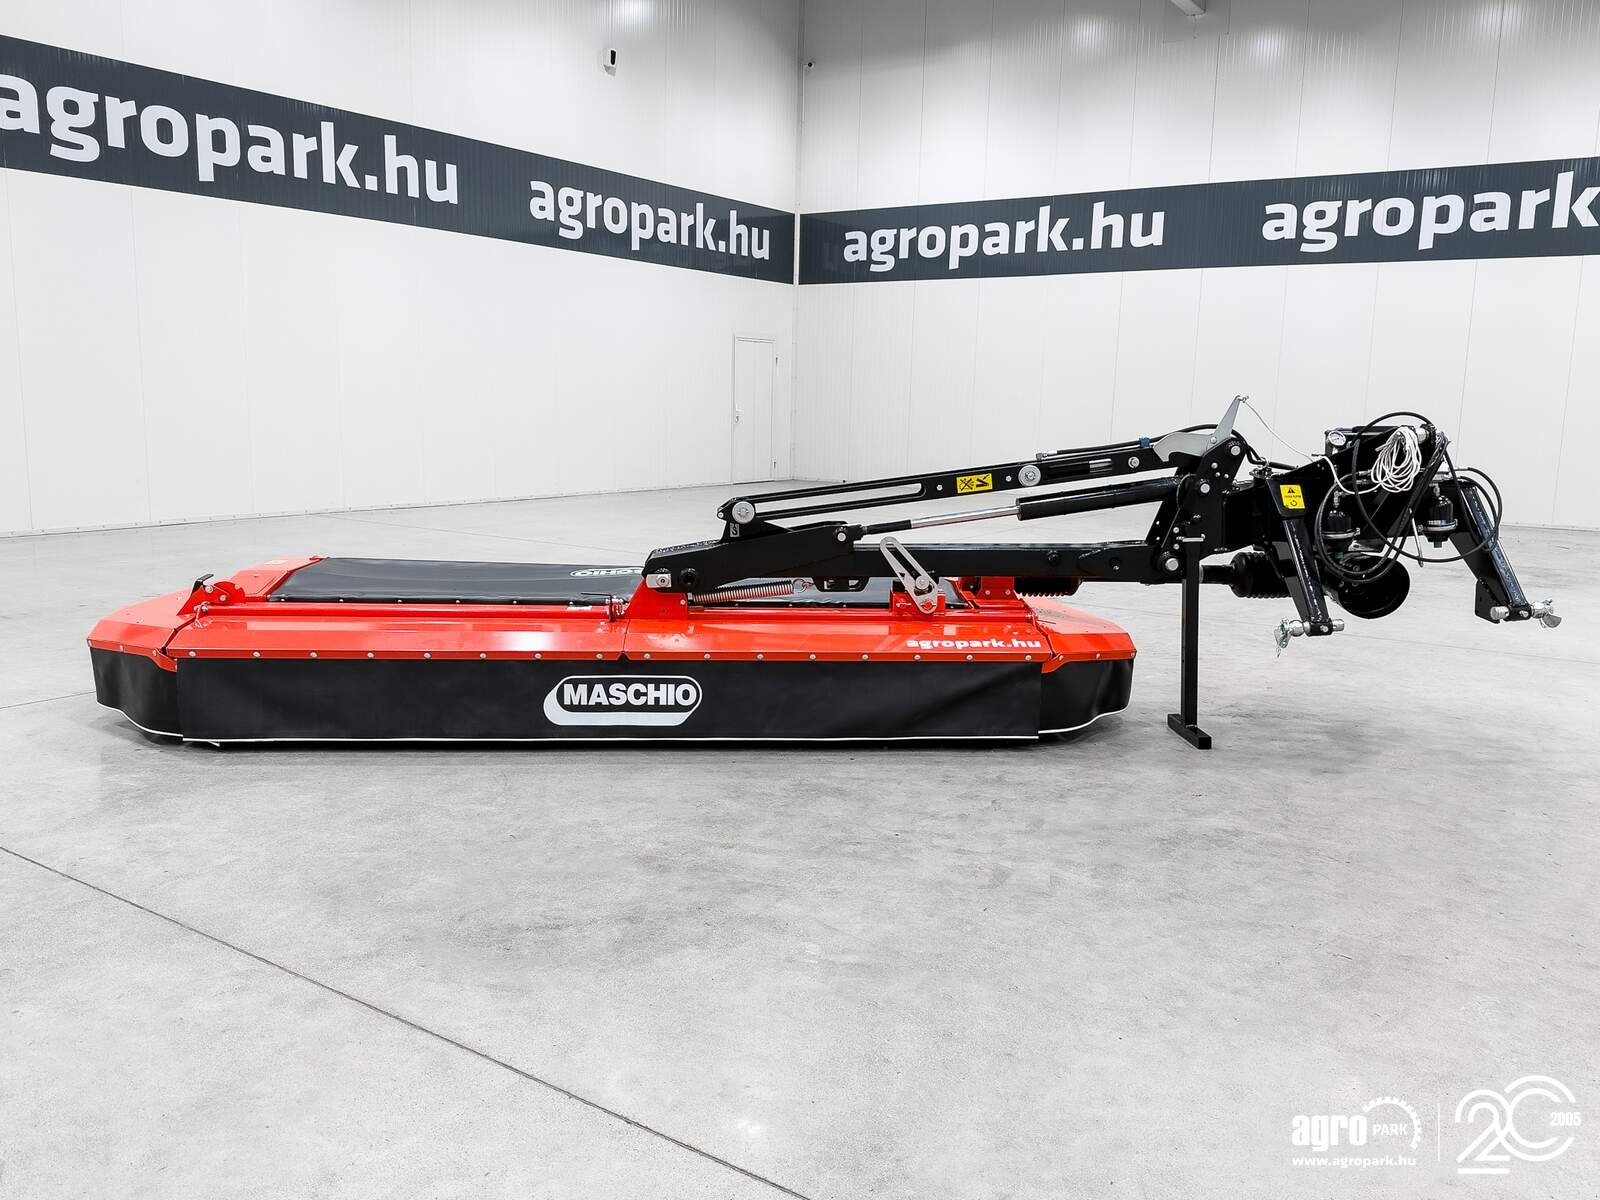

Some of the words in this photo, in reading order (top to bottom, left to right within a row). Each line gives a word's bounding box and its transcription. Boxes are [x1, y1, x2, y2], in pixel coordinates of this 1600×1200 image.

[0, 74, 459, 205] agropark.hu
[529, 180, 770, 261] agropark.hu
[843, 200, 1165, 271] agropark.hu
[1262, 170, 1600, 252] agropark
[905, 638, 1042, 650] agropark.hu
[563, 683, 697, 706] MASCHIO
